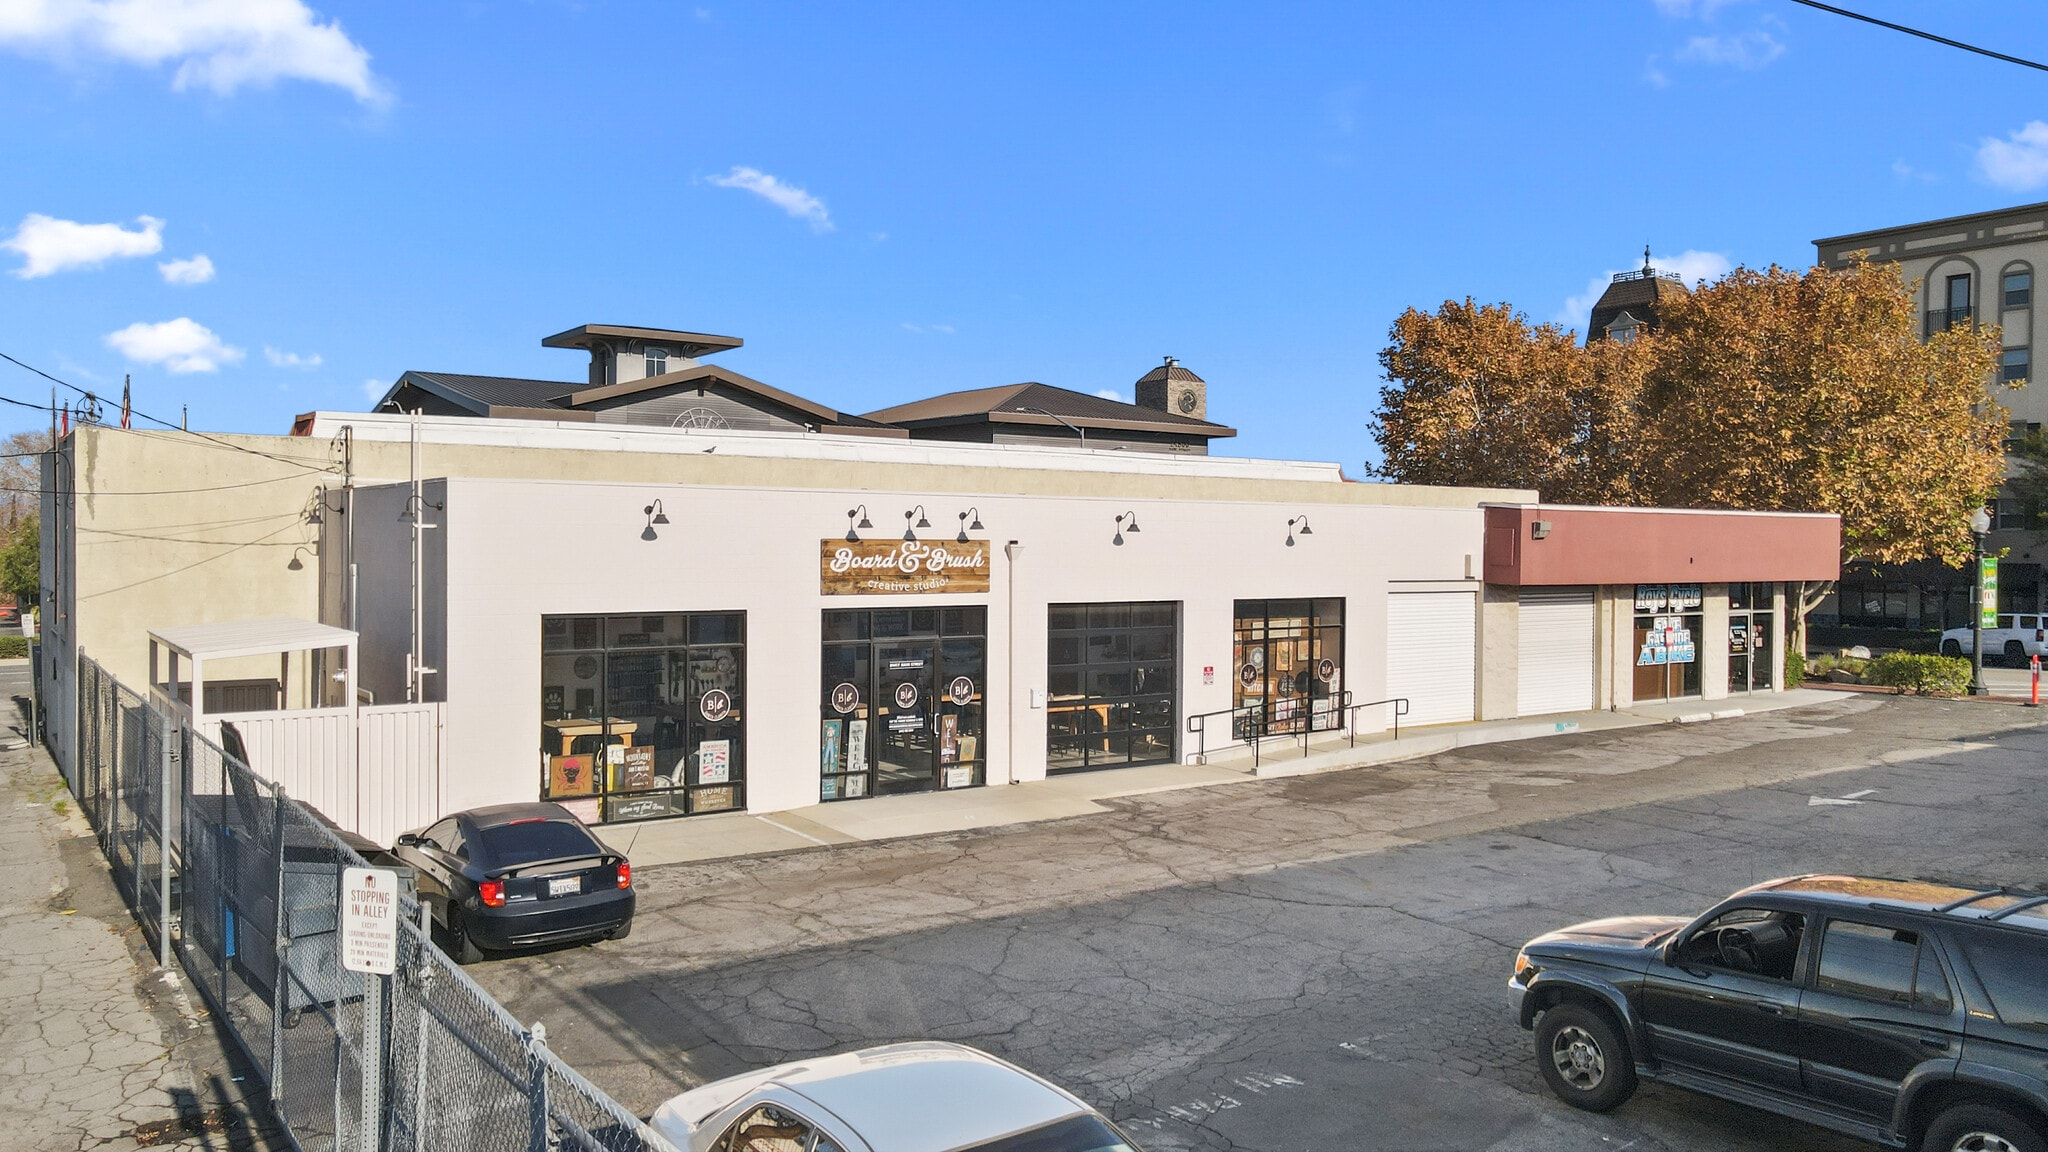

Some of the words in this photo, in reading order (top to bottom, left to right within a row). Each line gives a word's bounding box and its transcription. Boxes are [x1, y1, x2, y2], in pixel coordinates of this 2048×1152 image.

[830, 548, 898, 573] Board
[898, 540, 930, 573] &
[926, 548, 985, 572] Brush
[867, 579, 910, 592] creative
[1635, 585, 1667, 613] Roy's
[1669, 585, 1701, 612] Cycle
[1637, 645, 1654, 665] A
[1654, 642, 1695, 663] BIKE
[699, 787, 728, 797] HOME
[365, 877, 376, 888] NO
[351, 890, 390, 904] STOPPING
[352, 906, 360, 916] IN
[363, 906, 389, 918] ALLEY
